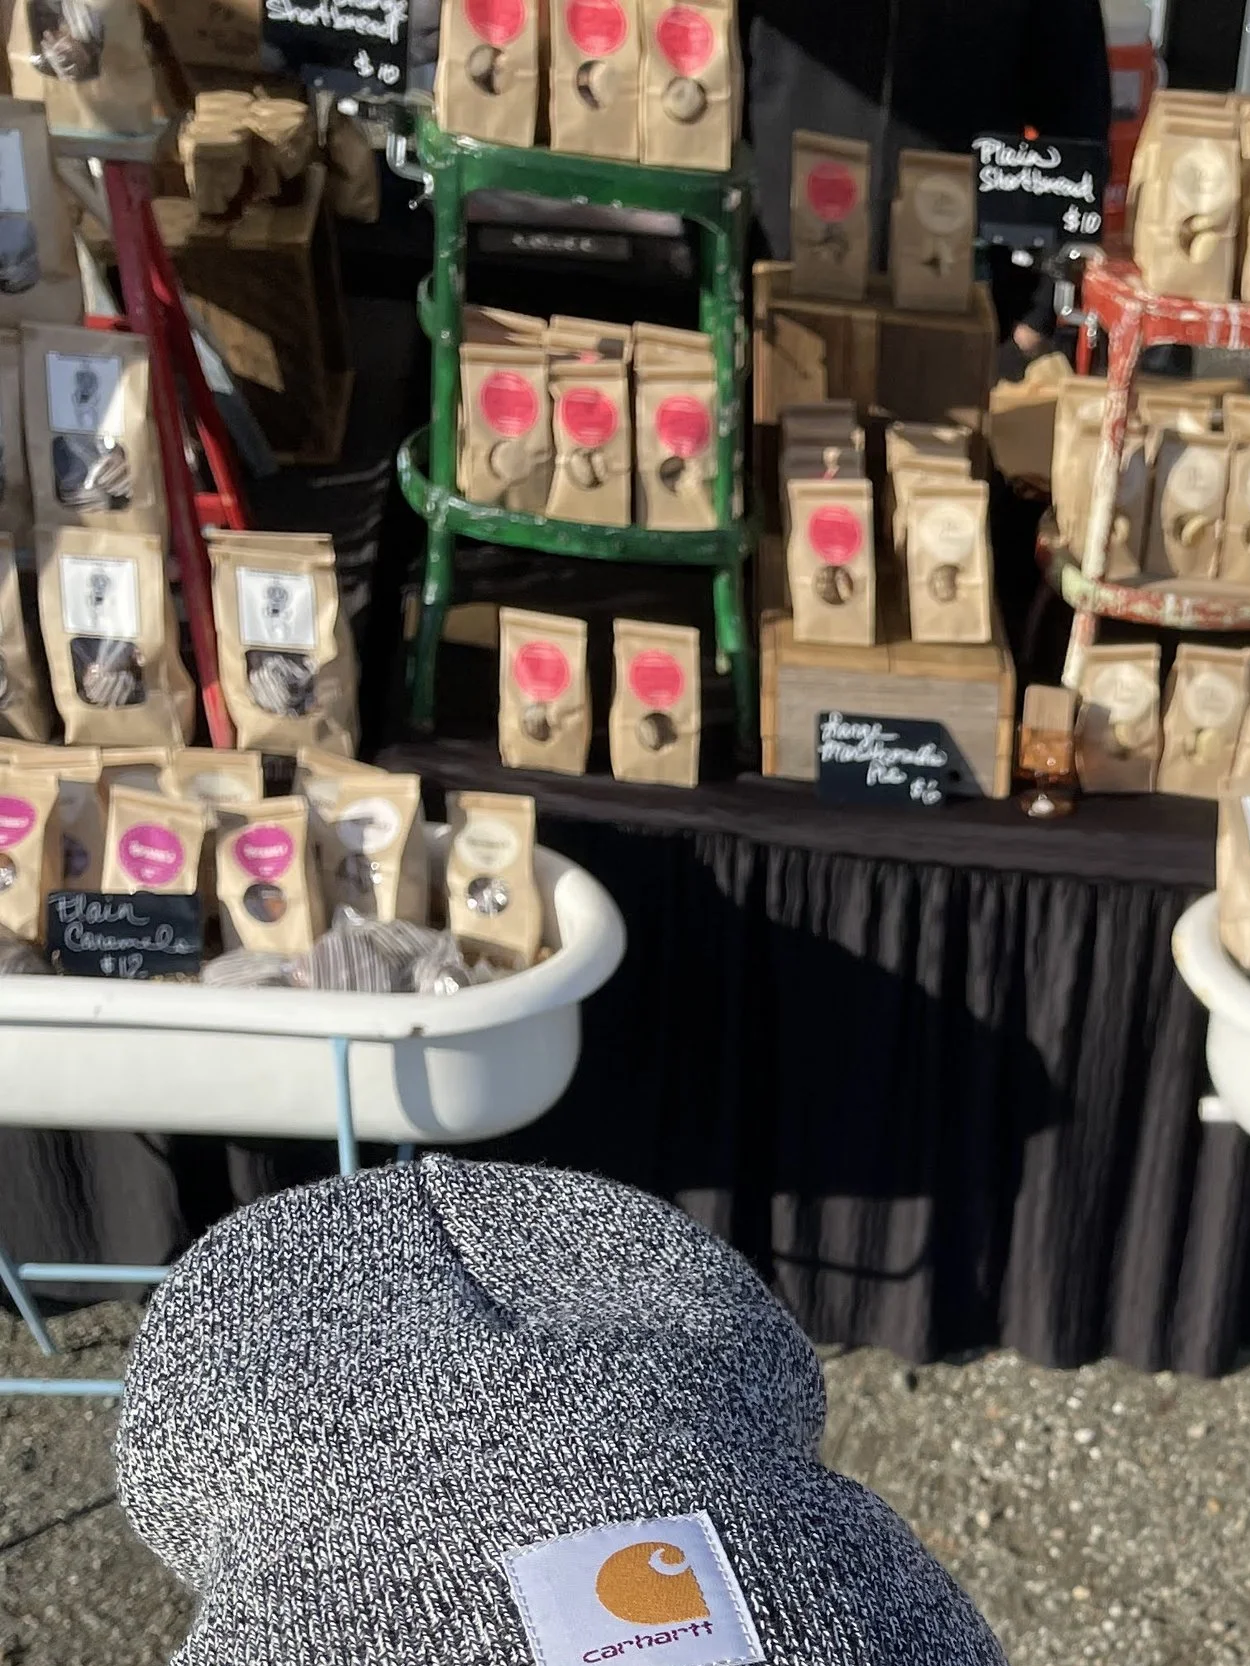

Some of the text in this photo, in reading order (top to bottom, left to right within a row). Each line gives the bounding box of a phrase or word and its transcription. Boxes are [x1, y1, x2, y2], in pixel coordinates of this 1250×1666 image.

[353, 49, 400, 86] $10
[971, 137, 1062, 169] Plain
[1062, 203, 1102, 234] $10
[100, 953, 150, 979] $12
[582, 1619, 714, 1664] carhartt
